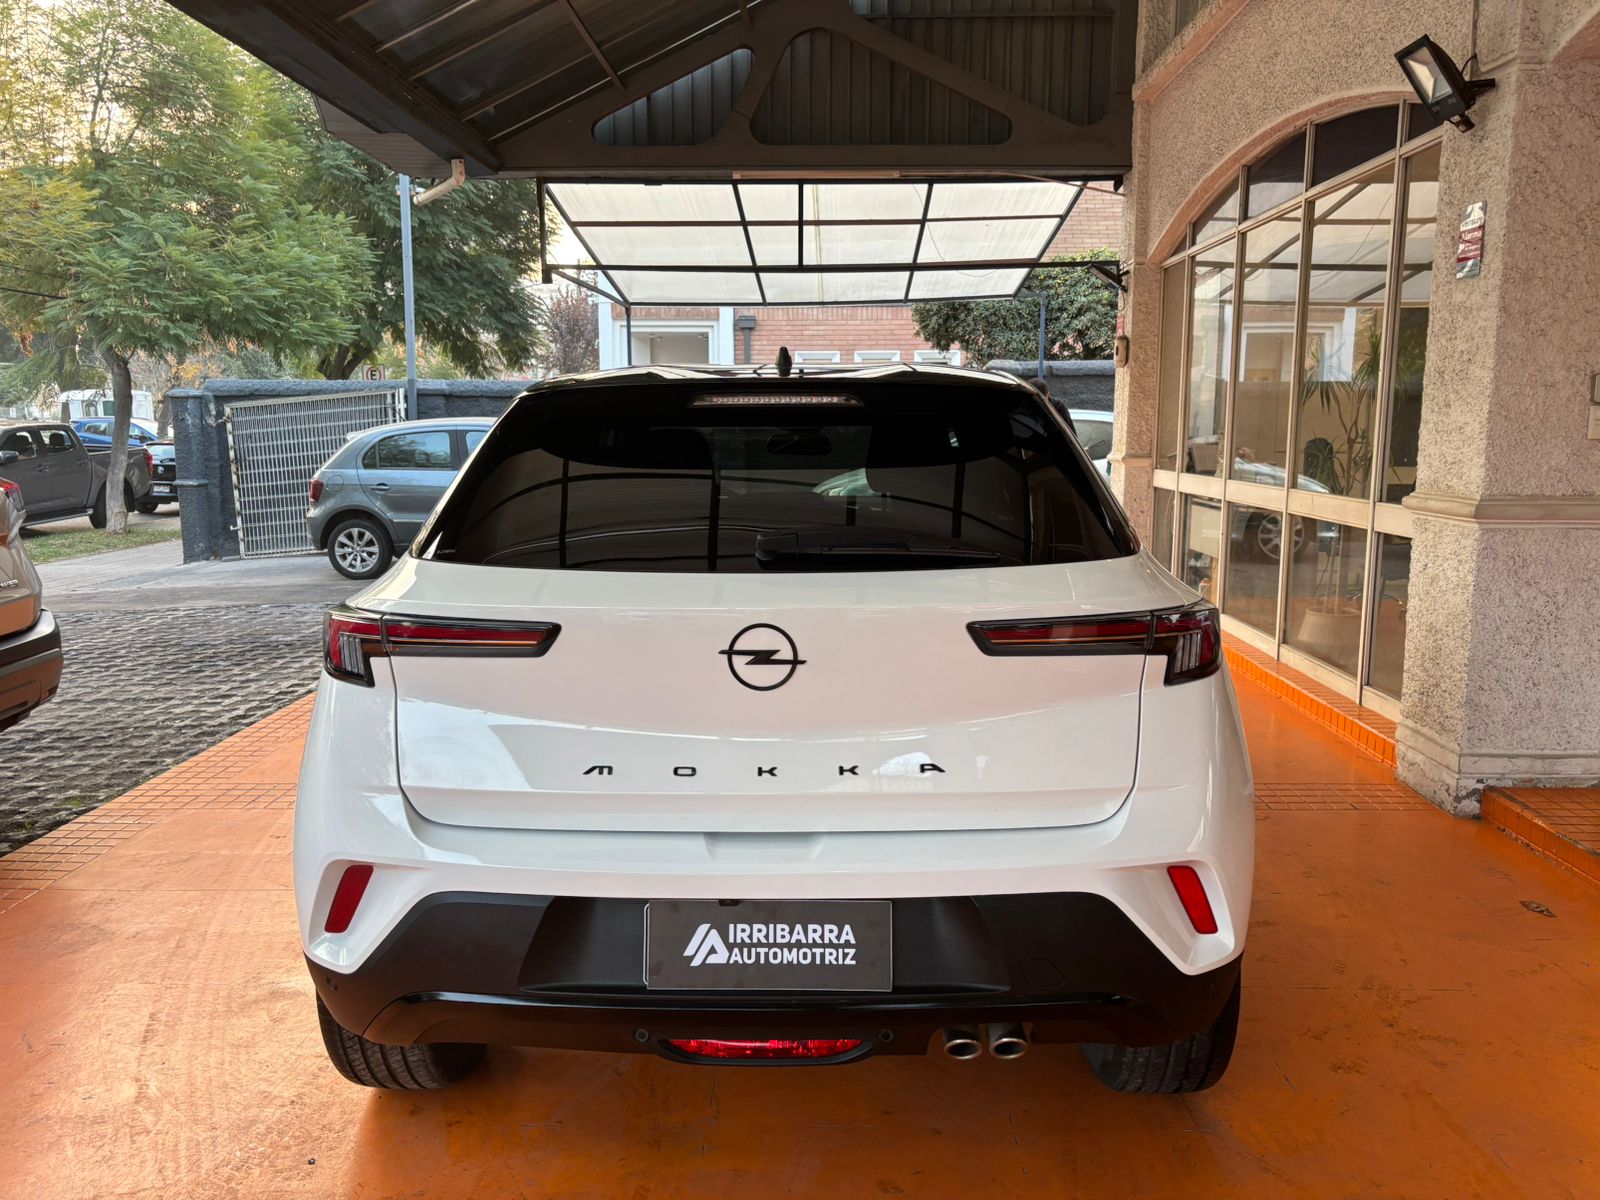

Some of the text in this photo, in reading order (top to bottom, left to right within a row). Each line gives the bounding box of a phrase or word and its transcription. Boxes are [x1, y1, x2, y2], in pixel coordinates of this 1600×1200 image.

[370, 369, 377, 380] E
[582, 763, 946, 777] MOKKA
[729, 923, 856, 944] IRRIBARRA
[729, 948, 856, 965] AUTOMOTRIZ
